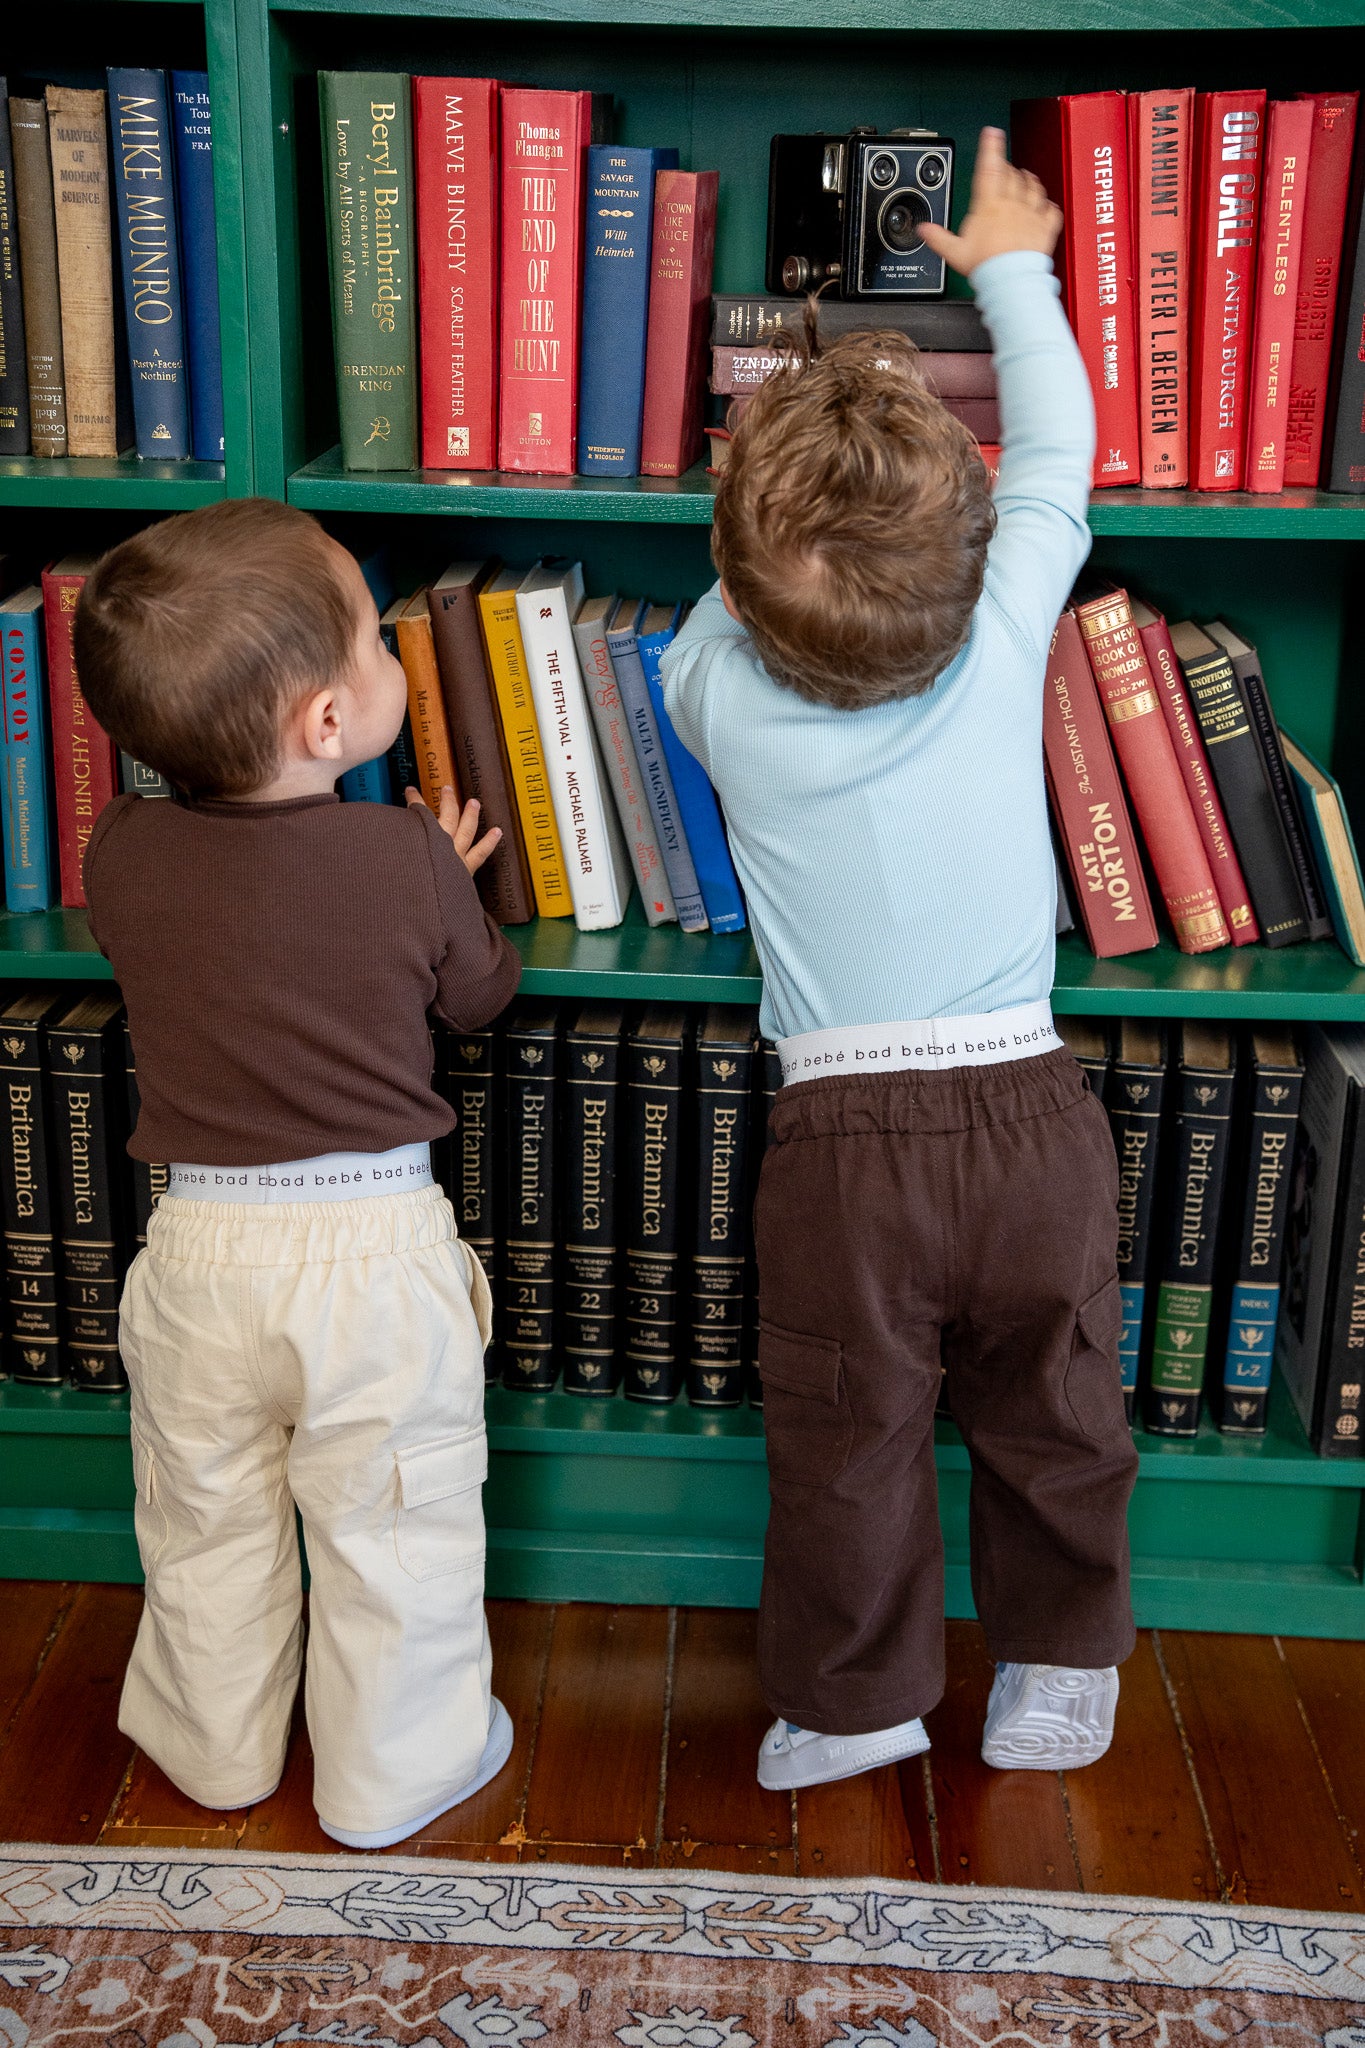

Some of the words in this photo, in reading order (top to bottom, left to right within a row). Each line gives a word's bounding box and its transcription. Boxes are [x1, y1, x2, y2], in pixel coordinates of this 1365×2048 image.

[176, 92, 195, 104] The
[56, 128, 99, 143] MARVELS
[117, 93, 163, 181] MIKE
[336, 119, 350, 157] Love
[366, 101, 398, 175] Beryl
[445, 94, 464, 174] MAEVE
[518, 121, 561, 140] Thomas
[1221, 111, 1260, 161] ON
[72, 150, 85, 163] OF
[514, 139, 564, 160] Flanagan
[609, 158, 627, 167] THE
[1152, 104, 1180, 217] MANHUNT
[60, 169, 100, 185] MODERN
[336, 161, 351, 180] by
[600, 174, 635, 183] SAVAGE
[61, 191, 101, 205] SCIENCE
[340, 184, 353, 205] All
[521, 177, 557, 213] THE
[594, 188, 640, 199] MOUNTAIN
[1094, 146, 1115, 225] STEPHEN
[664, 216, 683, 228] LIKE
[667, 202, 692, 214] TOWN
[1217, 173, 1256, 258] CALL
[340, 209, 354, 247] Sorts
[359, 190, 370, 267] BIOGRAPHY
[447, 184, 466, 275] BINCHY
[521, 219, 557, 253] END
[604, 229, 628, 241] Willi
[658, 230, 689, 242] ALICE
[1274, 156, 1296, 296] RELENTLESS
[126, 193, 173, 325] MUNRO
[343, 251, 355, 267] of
[371, 186, 402, 333] Bainbridge
[595, 245, 635, 259] Heinrich
[660, 258, 683, 268] NEVIL
[527, 259, 550, 293] OF
[657, 269, 684, 280] SHUTE
[1096, 230, 1118, 307] LEATHER
[343, 269, 356, 315] Means
[1151, 251, 1178, 321] PETER
[1309, 256, 1333, 341] RESPONSE
[450, 287, 465, 350] SCARLET
[519, 300, 555, 333] THE
[1223, 268, 1242, 342] ANITA
[729, 310, 737, 335] Stephen
[766, 318, 773, 327] of
[1101, 314, 1117, 343] TRUE
[153, 348, 161, 357] A
[513, 339, 561, 373] HUNT
[1103, 344, 1119, 390] COLOURS
[140, 371, 177, 383] Nothing
[343, 364, 406, 376] BRENDAN
[731, 370, 764, 383] Roshi
[1266, 342, 1281, 408] BEVERE
[359, 380, 393, 392] KING
[451, 353, 465, 418] FEATHER
[1218, 347, 1237, 429] BURGH
[32, 423, 66, 435] Cockle
[35, 409, 57, 420] shell
[1296, 388, 1317, 464] LEATHER
[447, 448, 470, 457] ORION
[518, 437, 552, 447] DUTTON
[594, 453, 625, 461] NICOLSON
[1154, 463, 1177, 474] CROWN
[1088, 636, 1111, 653] THE
[1112, 625, 1136, 645] NEW
[505, 638, 523, 675] JORDAN
[546, 649, 561, 675] THE
[586, 639, 614, 680] Crazy
[1094, 645, 1127, 667] BOOK
[1127, 641, 1140, 655] OF
[8, 629, 31, 745] CONVOY
[1107, 678, 1148, 699] SUB-ZWI
[1190, 666, 1234, 689] UNOFFICIAL
[1197, 679, 1233, 699] HISTORY
[416, 690, 428, 716] Man
[515, 676, 527, 709] MARY
[551, 680, 567, 716] FIFTH
[594, 681, 620, 712] Age
[1054, 676, 1074, 721] HOURS
[1199, 700, 1243, 720] FIELD-MARSHAL
[1202, 718, 1216, 727] SIR
[1215, 706, 1245, 722] WILLIAM
[1250, 681, 1269, 738] UNIVERSAL
[421, 720, 431, 733] in
[558, 719, 572, 747] VIAL
[609, 718, 624, 754] Thoughts
[1215, 719, 1236, 731] SLIM
[518, 724, 542, 767] DEAL
[618, 754, 625, 765] on
[1064, 723, 1087, 774] DISTANT
[1158, 648, 1176, 690] GOOD
[1170, 693, 1195, 748] HARBOR
[1190, 760, 1209, 800] ANITA
[1202, 800, 1229, 860] DIAMANT
[16, 757, 28, 796] Martin
[72, 733, 93, 817] BINCHY
[141, 769, 155, 780] 14
[426, 752, 440, 780] Cold
[620, 767, 631, 789] Being
[633, 708, 653, 755] MALTA
[647, 761, 679, 852] MAGNIFICENT
[527, 770, 547, 805] HER
[566, 771, 585, 826] MICHAEL
[627, 789, 638, 804] Old
[1078, 774, 1093, 794] The
[18, 799, 32, 869] Middlebrook
[534, 811, 551, 831] OF
[537, 837, 558, 867] ART
[575, 828, 593, 875] PALMER
[635, 842, 651, 886] MILLER
[646, 845, 658, 868] JANE
[1089, 802, 1138, 922] MORTON
[1079, 842, 1106, 893] KATE
[504, 861, 518, 910] DIARMUID
[543, 871, 562, 900] THE
[804, 1050, 845, 1068] bebé
[855, 1046, 891, 1060] bad
[965, 1037, 1007, 1054] bebé
[1014, 1030, 1039, 1046] bad
[8, 1083, 40, 1218] Britannica
[68, 1090, 94, 1225] Britannica
[462, 1089, 486, 1223] Britannica
[521, 1094, 545, 1227] Britannica
[582, 1098, 607, 1232] Britannica
[178, 1171, 207, 1184] bebé
[215, 1173, 248, 1186] bad
[267, 1174, 305, 1187] bad
[315, 1171, 363, 1186] bebé
[373, 1165, 403, 1180] bad
[409, 1162, 430, 1175] bebé
[643, 1102, 669, 1237] Britannica
[710, 1107, 738, 1242] Britannica
[1116, 1129, 1148, 1265] Britannica
[1179, 1132, 1216, 1268] Britannica
[1250, 1131, 1287, 1268] Britannica
[13, 1252, 44, 1260] Knowledge
[23, 1259, 41, 1267] Depth
[21, 1280, 40, 1296] 14
[81, 1288, 99, 1304] 15
[518, 1287, 538, 1304] 21
[580, 1292, 601, 1309] 22
[640, 1298, 659, 1314] 23
[705, 1303, 727, 1319] 24
[1239, 1299, 1270, 1310] INDEX
[1236, 1362, 1262, 1377] L-Z
